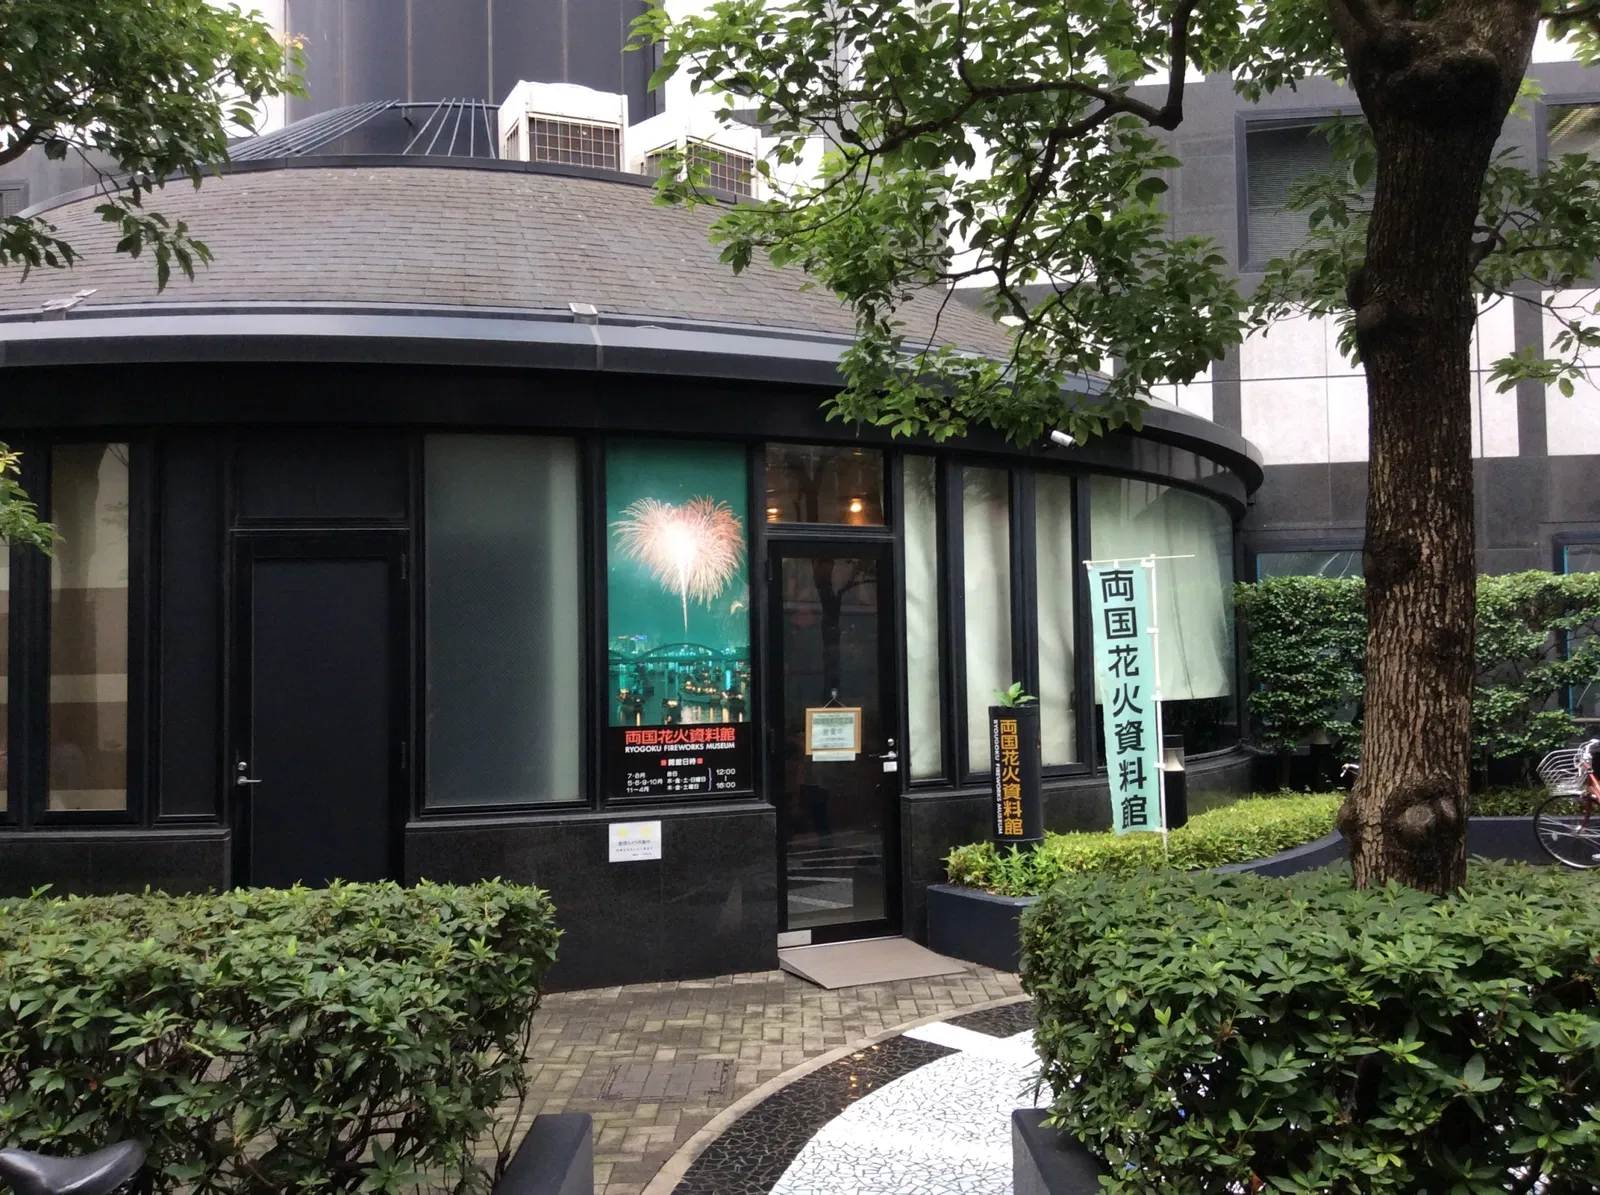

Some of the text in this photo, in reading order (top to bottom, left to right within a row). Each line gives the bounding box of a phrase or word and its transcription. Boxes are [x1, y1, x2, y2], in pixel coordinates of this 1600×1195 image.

[1099, 569, 1148, 830] 両国花火資料館
[625, 728, 735, 745] 両国花火資料館
[625, 745, 662, 753] RYOGOKU
[1000, 719, 1024, 835] 両国花火資料館
